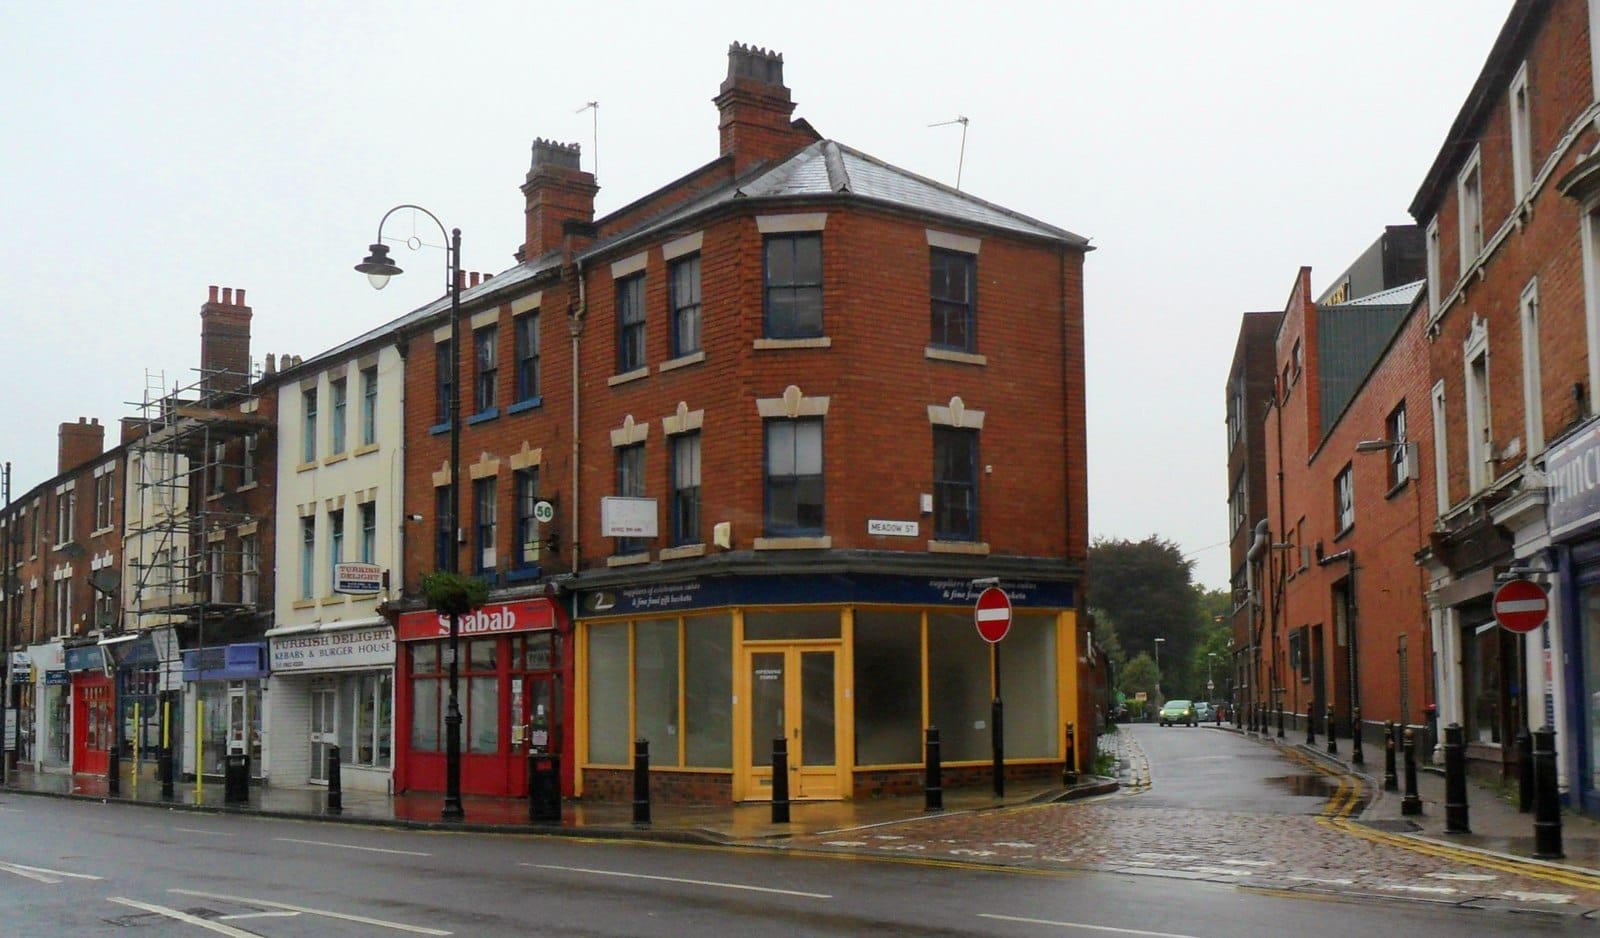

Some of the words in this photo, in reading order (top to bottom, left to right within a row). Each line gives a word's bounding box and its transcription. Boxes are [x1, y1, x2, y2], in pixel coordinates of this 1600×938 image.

[536, 505, 551, 518] 56
[871, 522, 902, 532] MEADOW
[905, 523, 914, 533] ST
[594, 592, 616, 610] 2
[273, 636, 329, 650] TURKISH
[332, 629, 393, 645] DELIGHT
[274, 650, 305, 660] KEBABS
[320, 646, 353, 658] BURGER
[358, 642, 391, 654] HOUSE
